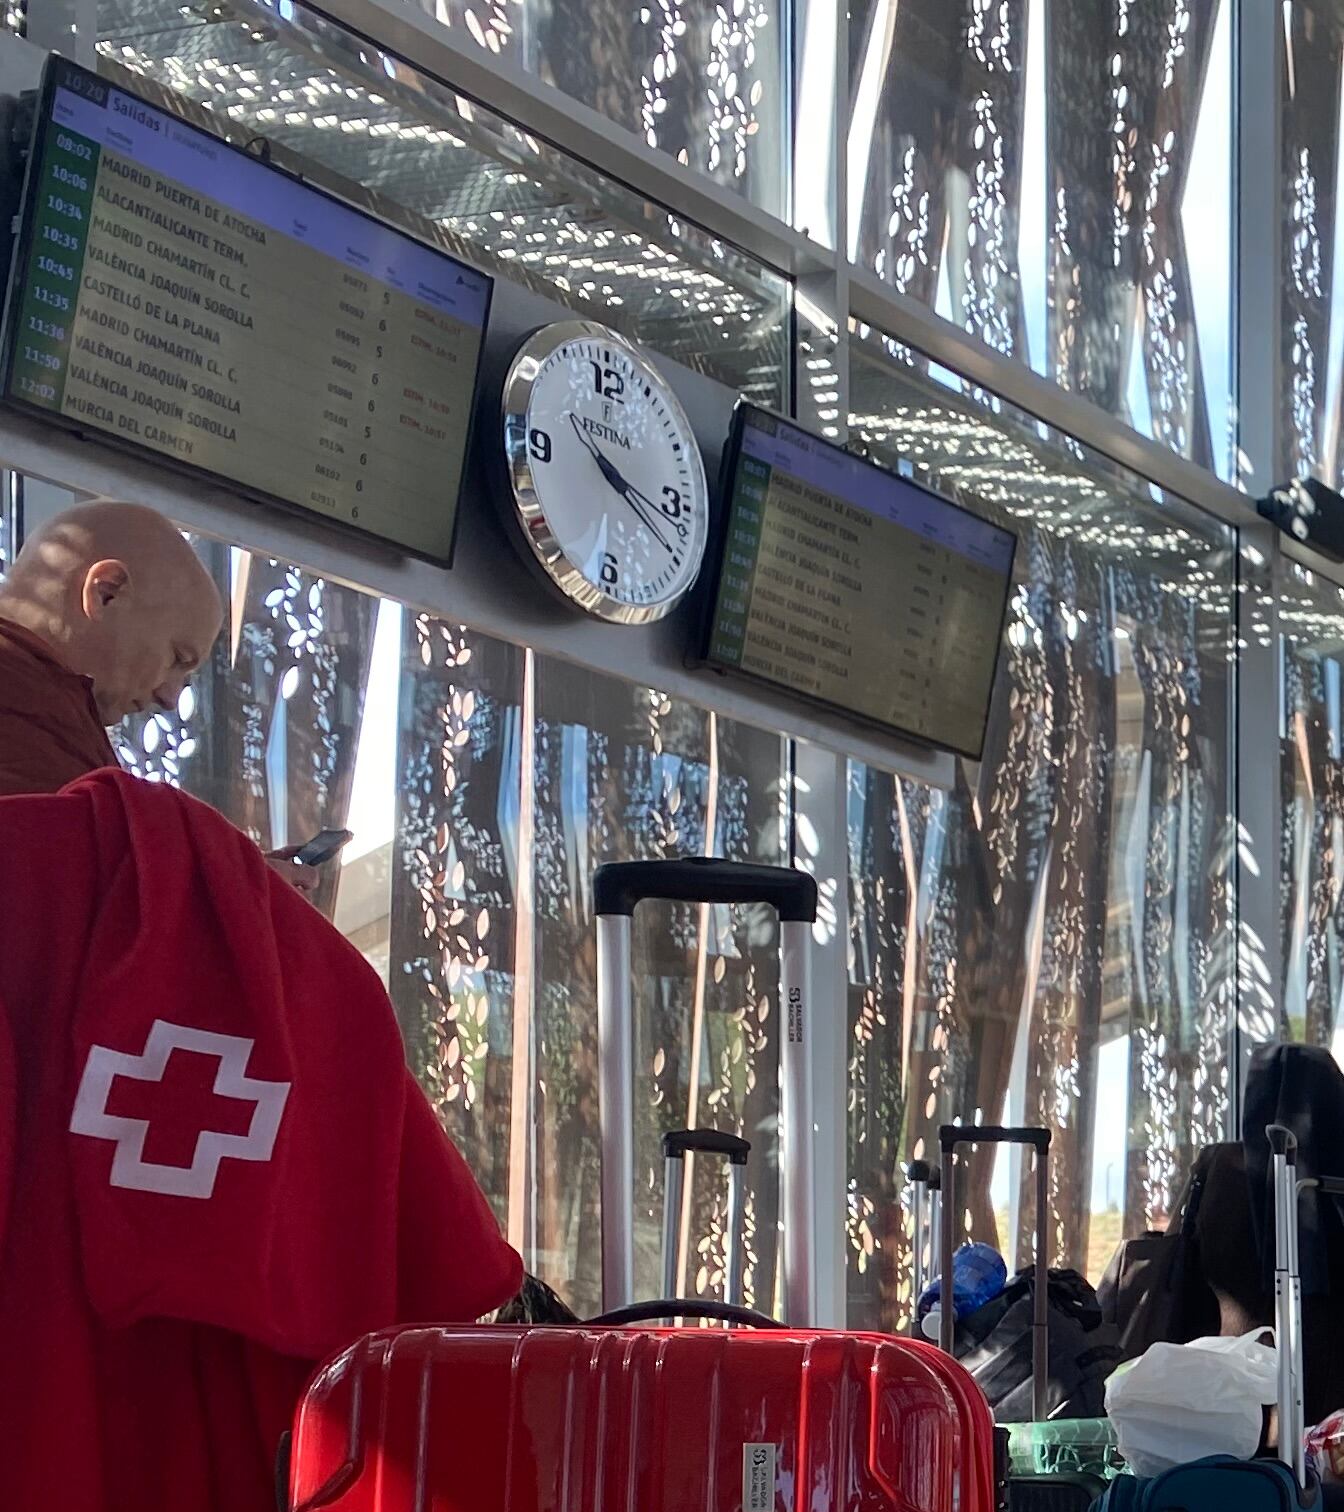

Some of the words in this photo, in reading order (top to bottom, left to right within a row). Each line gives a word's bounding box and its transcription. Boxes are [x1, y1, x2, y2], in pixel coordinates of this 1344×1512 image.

[64, 68, 104, 101] 1020
[112, 95, 161, 133] Salidas
[47, 193, 82, 221] 10:34
[92, 214, 143, 250] MADRID
[146, 236, 216, 283] CHAMARTÍN
[218, 272, 236, 292] CL.
[375, 344, 383, 359] 5
[51, 163, 87, 191] 10:06
[96, 184, 210, 249] ALACANT/ALICANTE
[211, 238, 249, 268] TERM.
[378, 317, 387, 332] 6
[56, 132, 91, 161] 08:02
[101, 154, 151, 190] MADRID
[154, 180, 200, 214] PUERTA
[203, 204, 220, 223] DE
[222, 212, 267, 246] ATOCHA
[383, 290, 390, 305] 5
[33, 285, 68, 311] 11:35
[78, 303, 129, 336] MADRID
[132, 323, 204, 367] CHAMARTÍN
[206, 357, 224, 376] CL.
[363, 425, 371, 440] 5
[37, 254, 73, 281] 10:45
[82, 271, 141, 311] CASTELLÓ
[144, 301, 162, 319] DE
[164, 309, 179, 327] LA
[182, 317, 221, 345] PLANA
[367, 398, 375, 413] 6
[42, 223, 77, 251] 10:35
[149, 268, 202, 309] JOAQUÍN
[204, 296, 254, 330] SOROLLA
[371, 371, 379, 386] 6
[24, 345, 60, 370] 11:50
[131, 385, 184, 422] JOAQUÍN
[186, 410, 237, 442] SOROLLA
[354, 478, 363, 492] 6
[135, 356, 188, 394] JOAQUÍN
[190, 381, 241, 414] SOROLLA
[358, 451, 368, 466] 6
[582, 417, 631, 450] FESTINA
[590, 361, 625, 404] 12
[19, 376, 55, 401] 12:02
[64, 394, 114, 424] MURCIA
[118, 414, 141, 434] DEL
[143, 424, 193, 455] CARMEN
[350, 504, 359, 519] 6
[530, 429, 551, 463] 9
[661, 486, 681, 517] 3
[601, 553, 618, 584] 6
